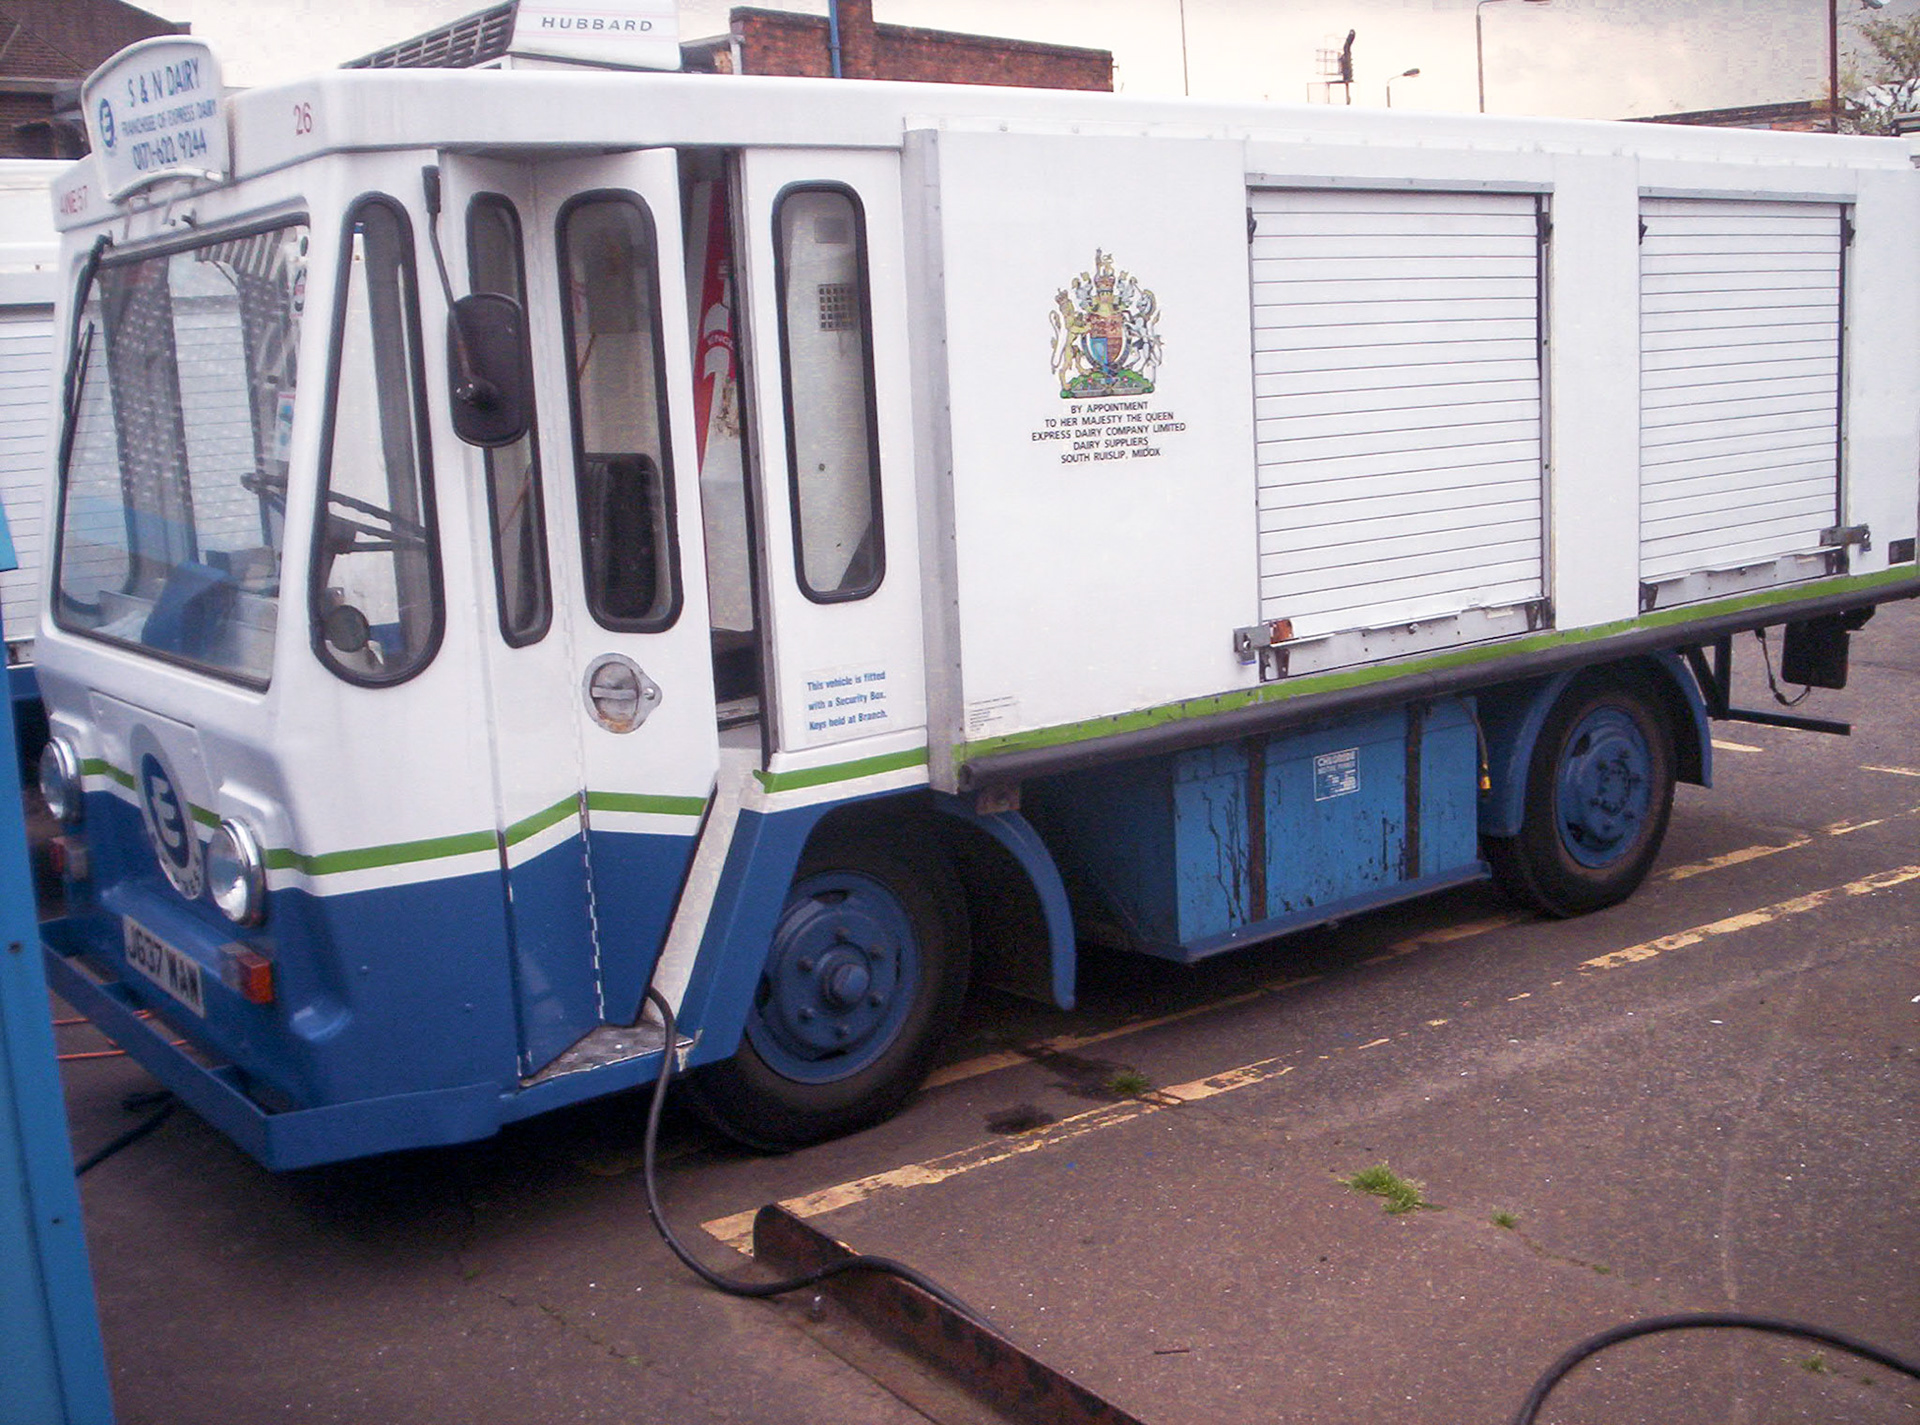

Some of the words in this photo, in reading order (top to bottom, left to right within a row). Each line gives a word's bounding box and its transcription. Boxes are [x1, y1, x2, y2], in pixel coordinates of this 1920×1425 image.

[541, 17, 653, 32] HUBBARD
[127, 78, 136, 108] S
[140, 75, 149, 104] &
[151, 70, 163, 100] N
[165, 57, 200, 97] DAIRY
[157, 111, 166, 129] OF
[167, 104, 195, 127] EXPRESS
[196, 99, 217, 119] DAIRY
[293, 102, 313, 136] 26
[132, 135, 178, 171] 0171-622
[178, 127, 207, 159] 9244
[1070, 405, 1082, 414] BY
[1086, 401, 1148, 413] APPOINTMENT
[1045, 418, 1057, 428] TO
[1060, 417, 1078, 427] HER
[1081, 414, 1123, 426] MAJESTY
[1126, 413, 1142, 423] THE
[1145, 411, 1174, 422] QUEEN
[1031, 429, 1071, 441] EXPRESS
[1075, 427, 1102, 438] DAIRY
[1105, 424, 1149, 436] COMPANY
[1152, 422, 1186, 433] LIMITED
[1073, 440, 1100, 450] DAIRY
[1104, 437, 1149, 448] SUPPLIERS
[1060, 453, 1090, 464] SOUTH
[807, 680, 824, 691] This
[826, 676, 852, 688] vehicle
[855, 675, 862, 684] is
[863, 671, 886, 682] fitted
[808, 700, 826, 711] with
[827, 700, 834, 708] a
[835, 693, 867, 706] Security
[808, 720, 827, 731] Keys
[829, 716, 846, 727] held
[847, 715, 856, 724] at
